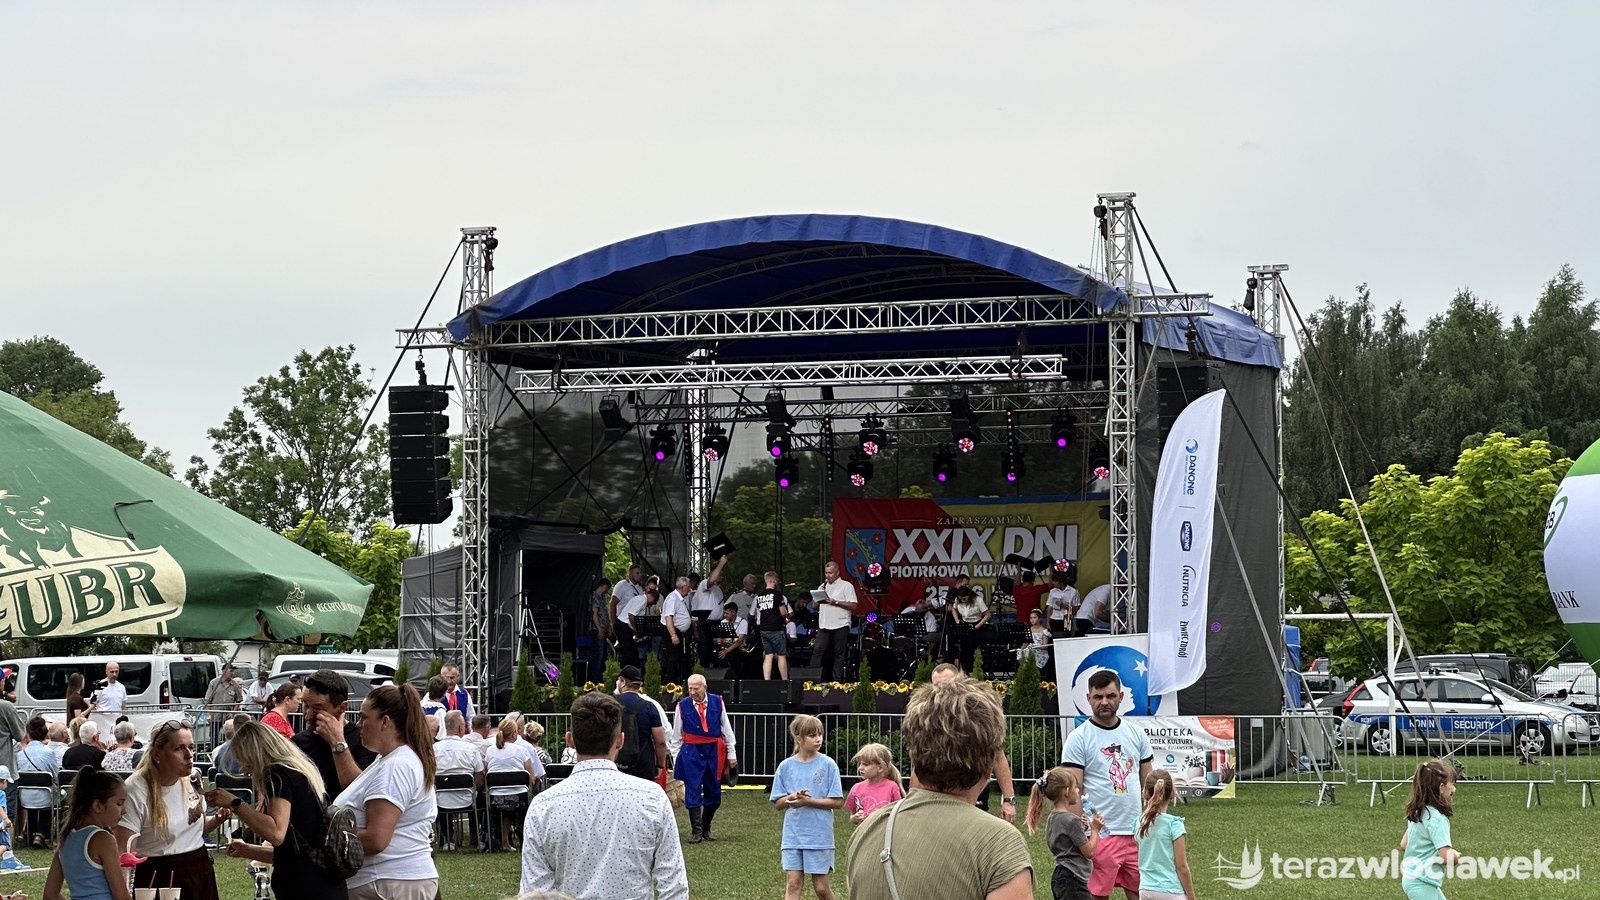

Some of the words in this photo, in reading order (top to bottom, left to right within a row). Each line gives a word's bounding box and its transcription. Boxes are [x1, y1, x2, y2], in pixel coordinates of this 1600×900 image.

[936, 515, 1013, 526] ZAPRASZAMY
[1016, 514, 1033, 524] NA
[890, 528, 994, 563] XXIX
[1003, 524, 1078, 562] DNI
[889, 565, 970, 578] PIOTRKOWA
[1181, 568, 1190, 608] NUTRICIA
[1409, 719, 1435, 728] KONN
[1454, 720, 1495, 729] SECURITY
[1144, 728, 1193, 737] BLIOTEKA
